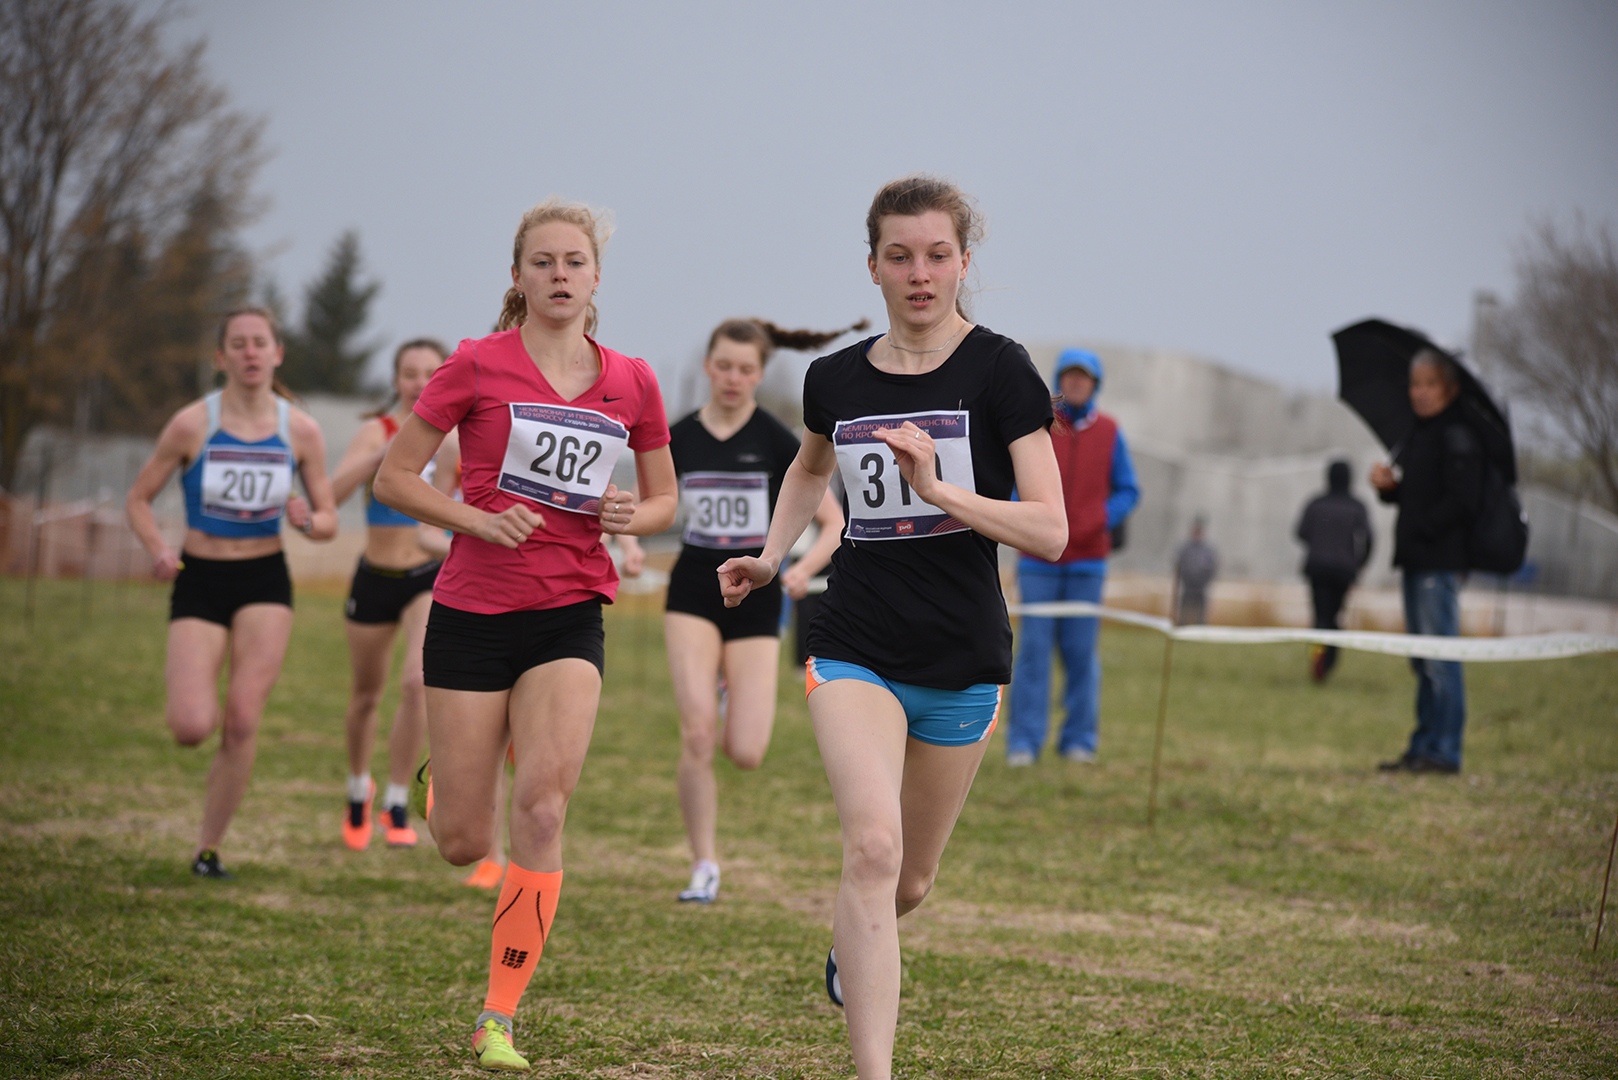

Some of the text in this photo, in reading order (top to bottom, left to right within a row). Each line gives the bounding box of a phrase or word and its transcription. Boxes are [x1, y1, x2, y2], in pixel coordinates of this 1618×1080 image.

[533, 412, 564, 422] КРОССУ
[842, 423, 894, 432] ЧЕМПИОНАТ
[914, 418, 958, 427] РВЕНСТВА
[530, 431, 602, 485] 262
[222, 468, 274, 502] 207
[698, 495, 749, 529] 309
